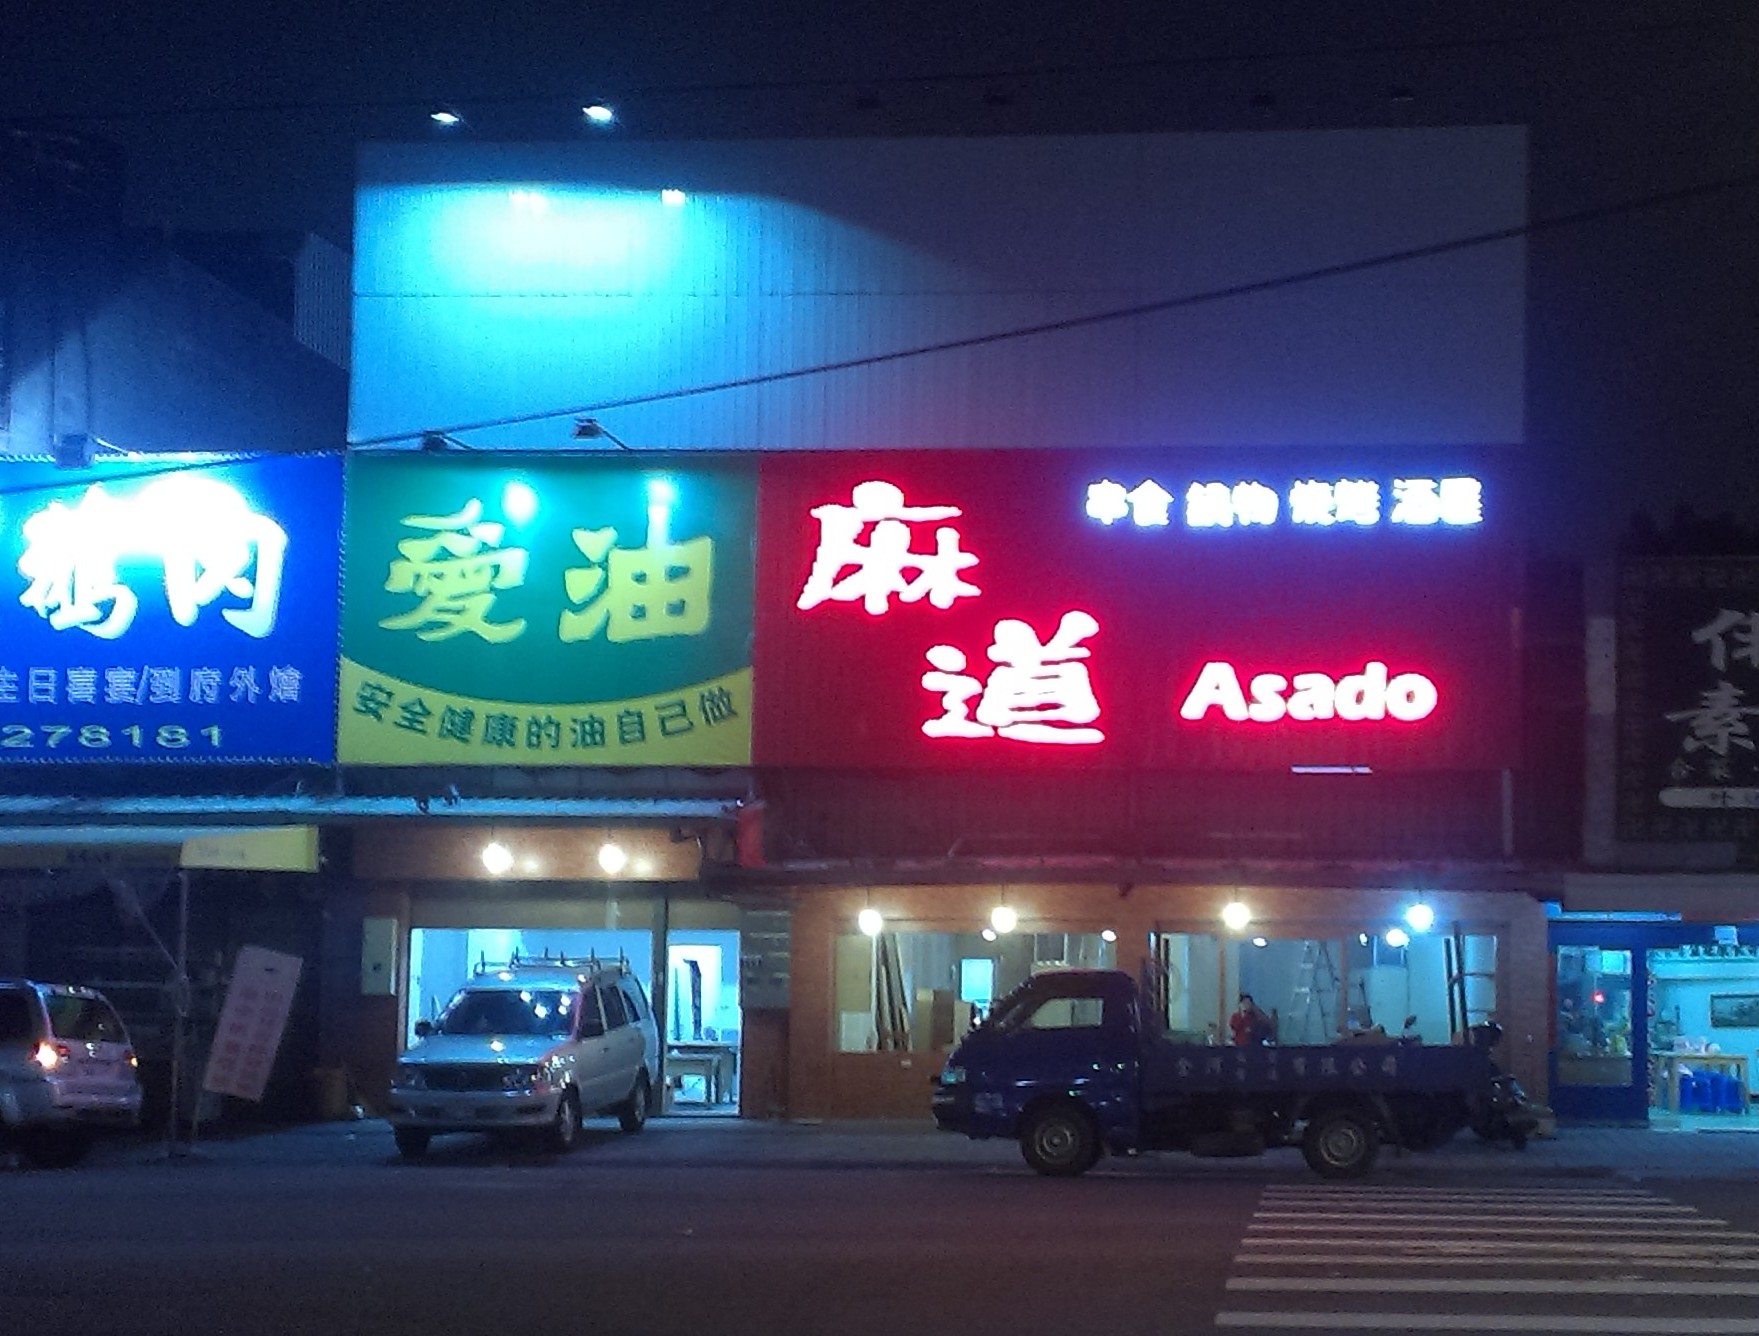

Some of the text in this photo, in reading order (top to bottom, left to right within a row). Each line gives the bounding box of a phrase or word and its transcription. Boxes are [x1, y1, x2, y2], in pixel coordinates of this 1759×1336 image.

[378, 492, 713, 645] 愛油
[352, 681, 739, 751] 安全健康的油自己做
[1180, 661, 1438, 722] Asado
[1, 723, 222, 749] 278181
